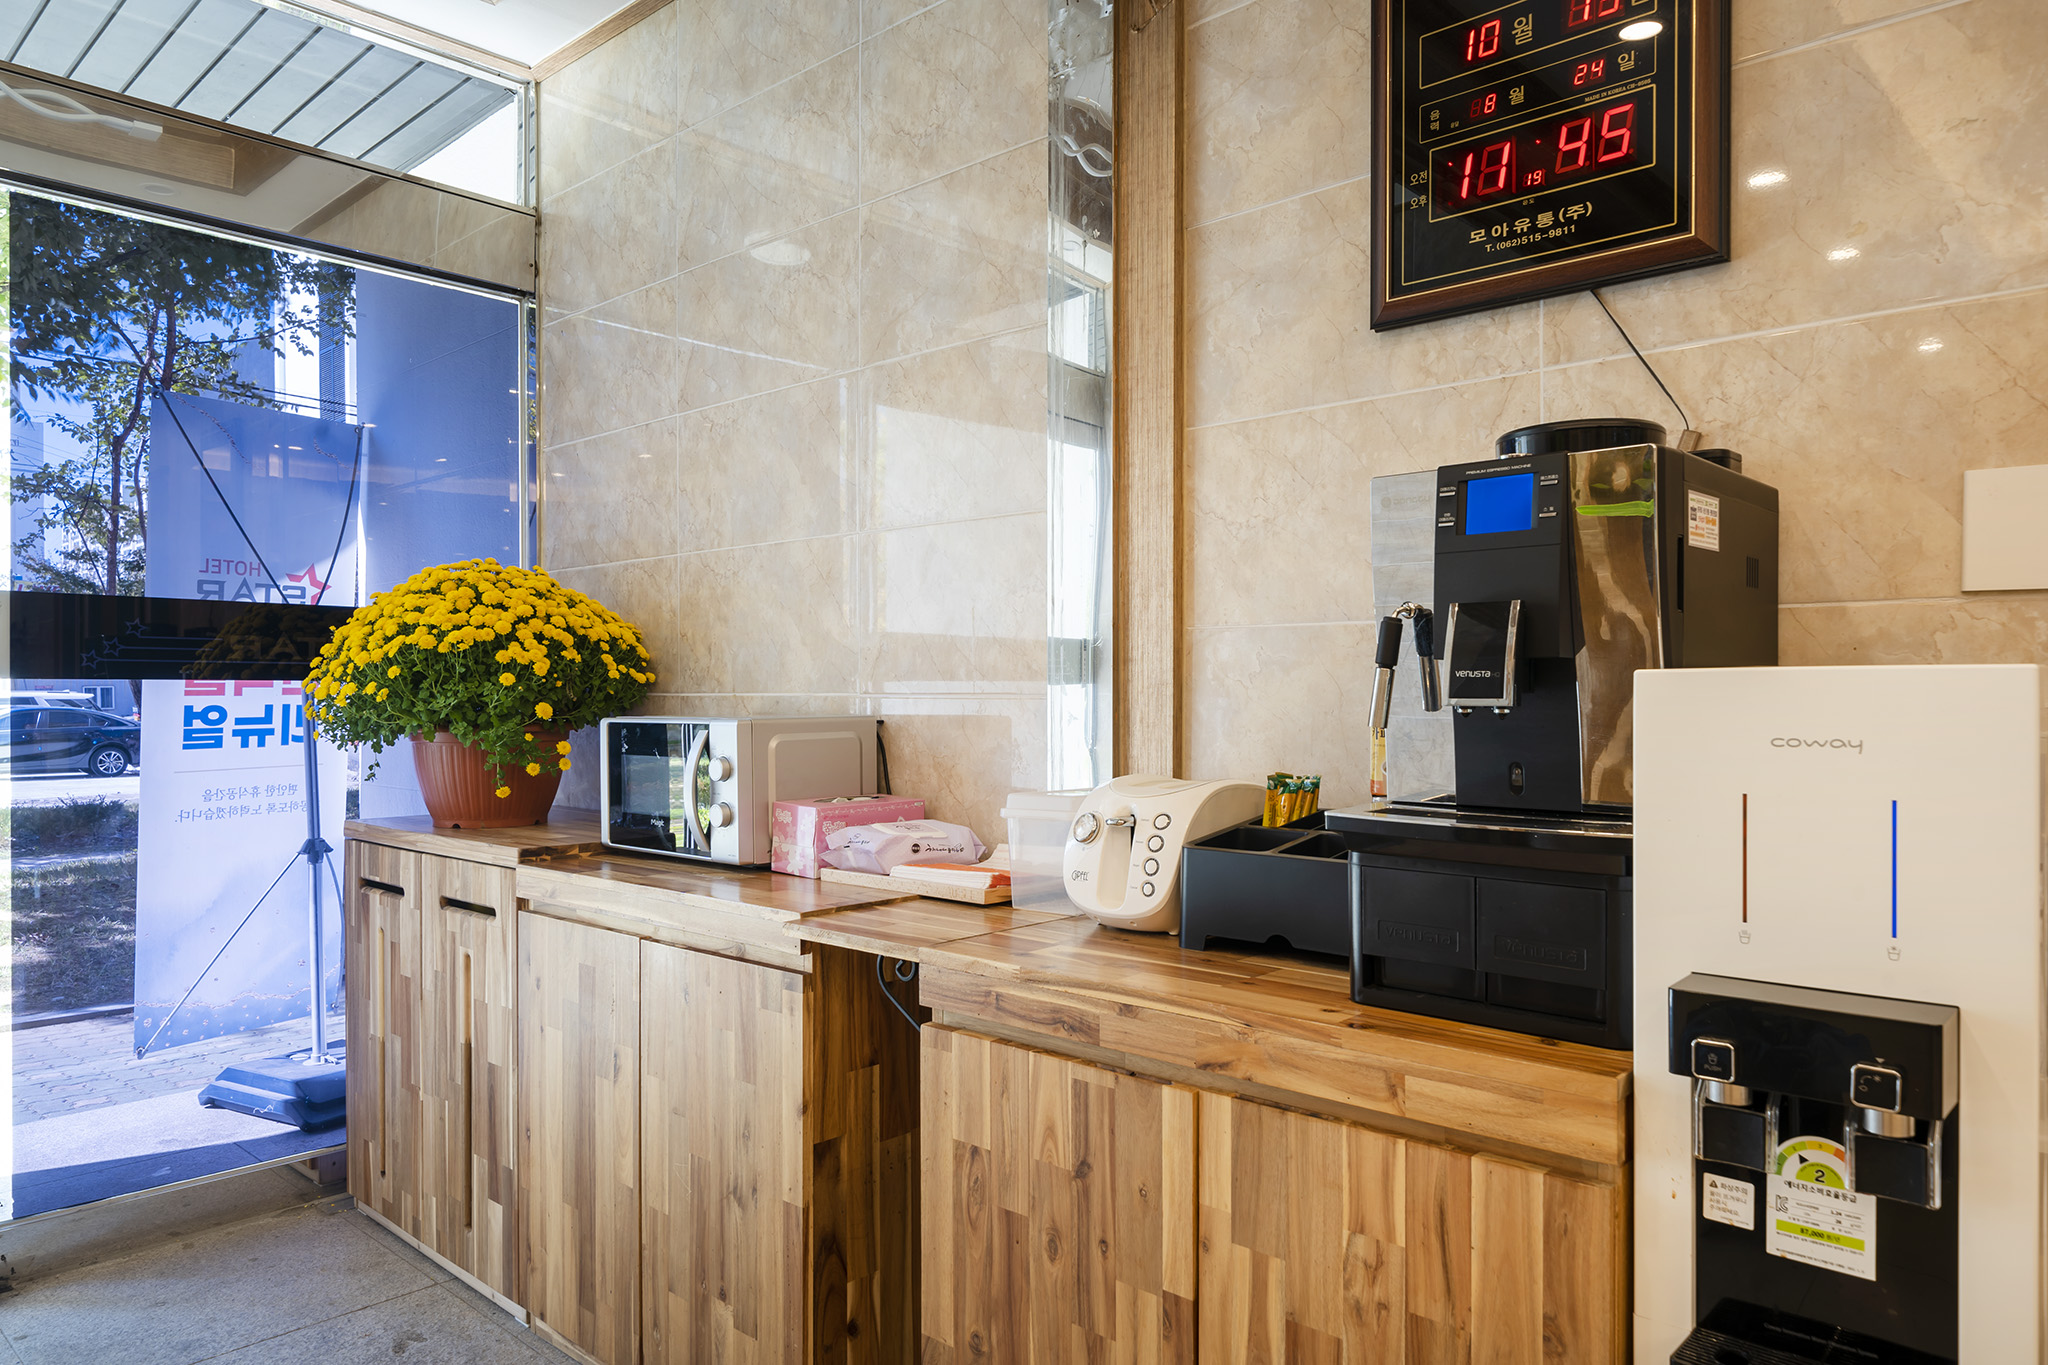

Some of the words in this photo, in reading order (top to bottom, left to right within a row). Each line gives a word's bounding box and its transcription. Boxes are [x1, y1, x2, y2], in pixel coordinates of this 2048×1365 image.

[1466, 19, 1501, 62] 10
[1511, 13, 1533, 46] 월
[1572, 59, 1605, 86] 24
[1617, 50, 1635, 72] 일
[1483, 93, 1497, 114] 8
[1508, 85, 1525, 105] 월
[1607, 86, 1626, 97] KOREA
[1409, 170, 1428, 186] 오전
[1527, 170, 1542, 187] 19
[1409, 195, 1428, 210] 오후
[1770, 737, 1863, 755] coway
[1814, 1169, 1826, 1184] 2
[1784, 1180, 1858, 1203] 에너지소비효율등급
